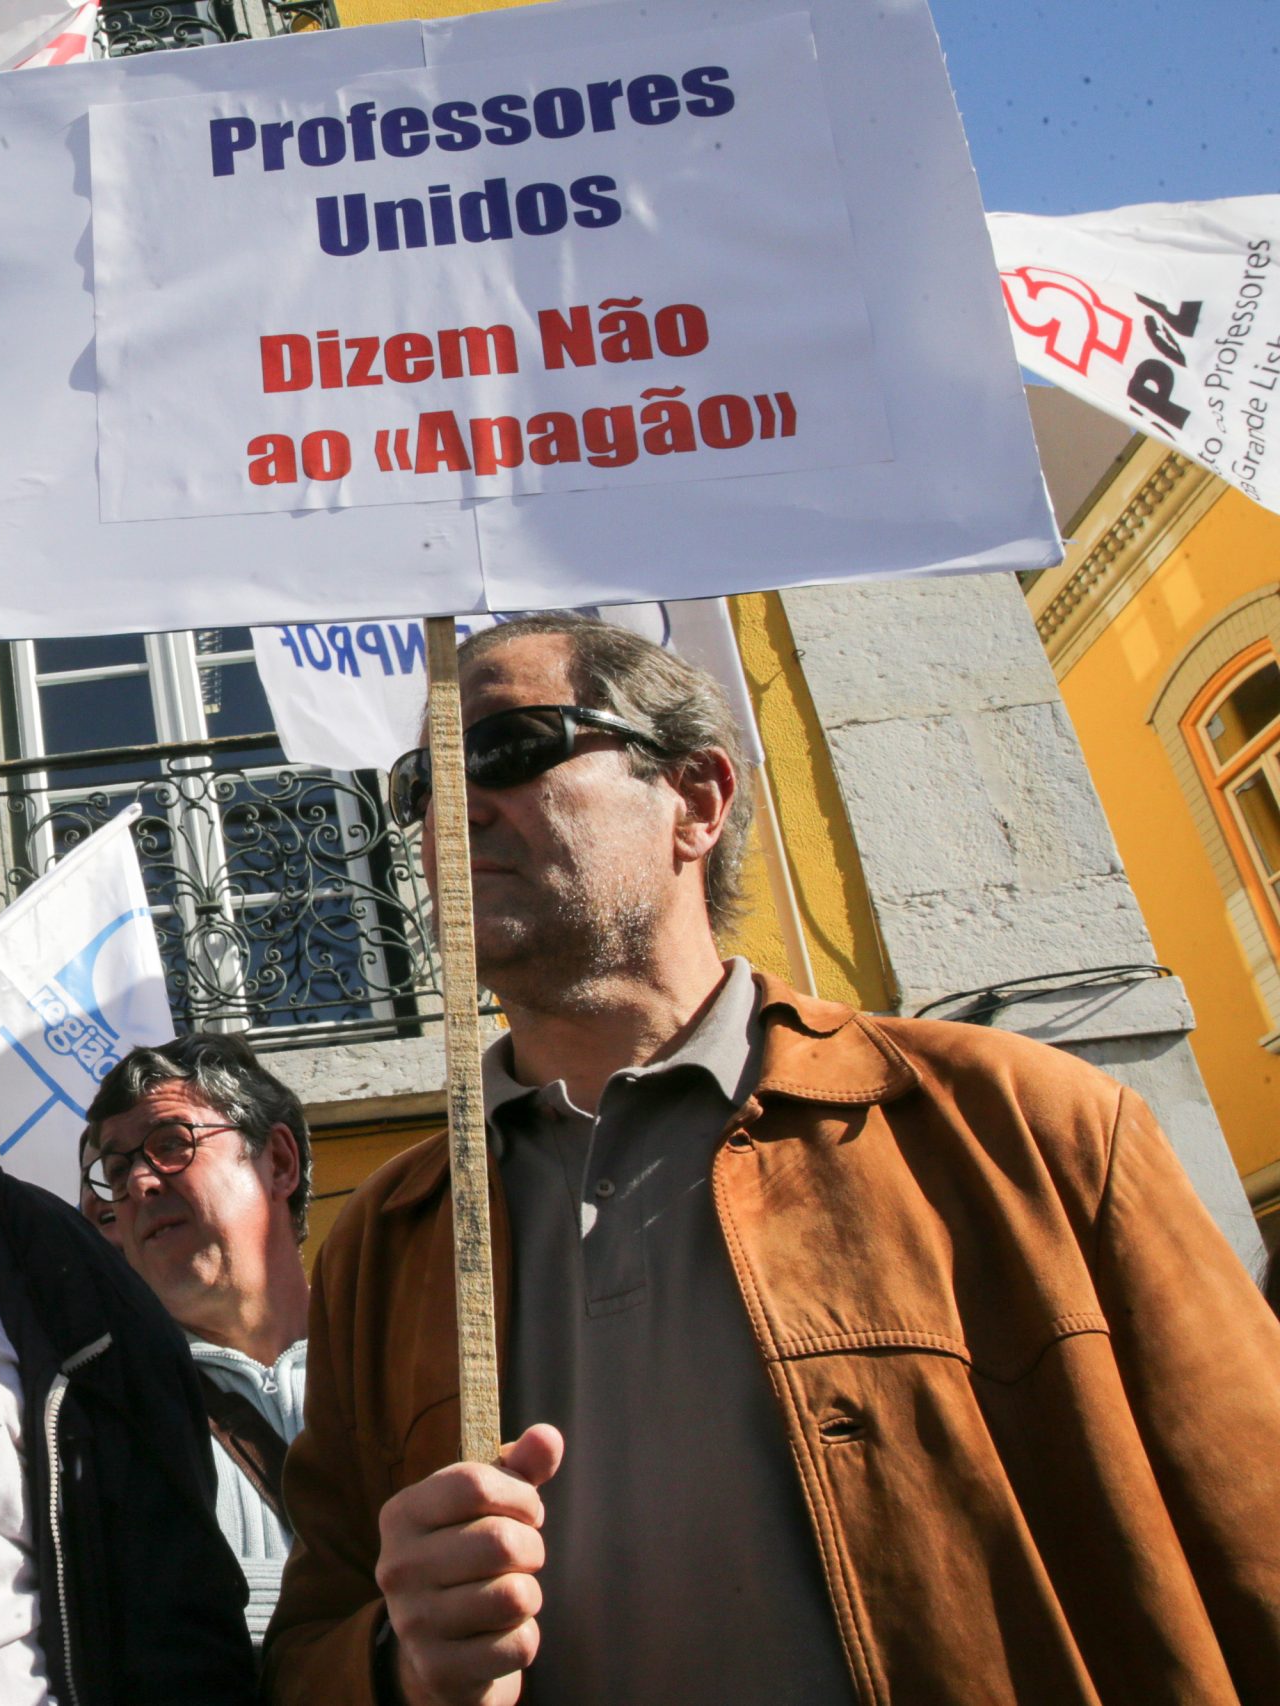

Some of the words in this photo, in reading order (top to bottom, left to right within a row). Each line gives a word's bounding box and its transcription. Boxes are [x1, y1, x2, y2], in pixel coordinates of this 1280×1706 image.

[210, 65, 735, 177] Professores
[316, 174, 622, 257] Unidos
[260, 323, 519, 393] Dizem
[537, 296, 709, 370] Não
[1204, 239, 1270, 392] Professores
[246, 429, 352, 485] ao
[374, 385, 797, 477] «Apagão»
